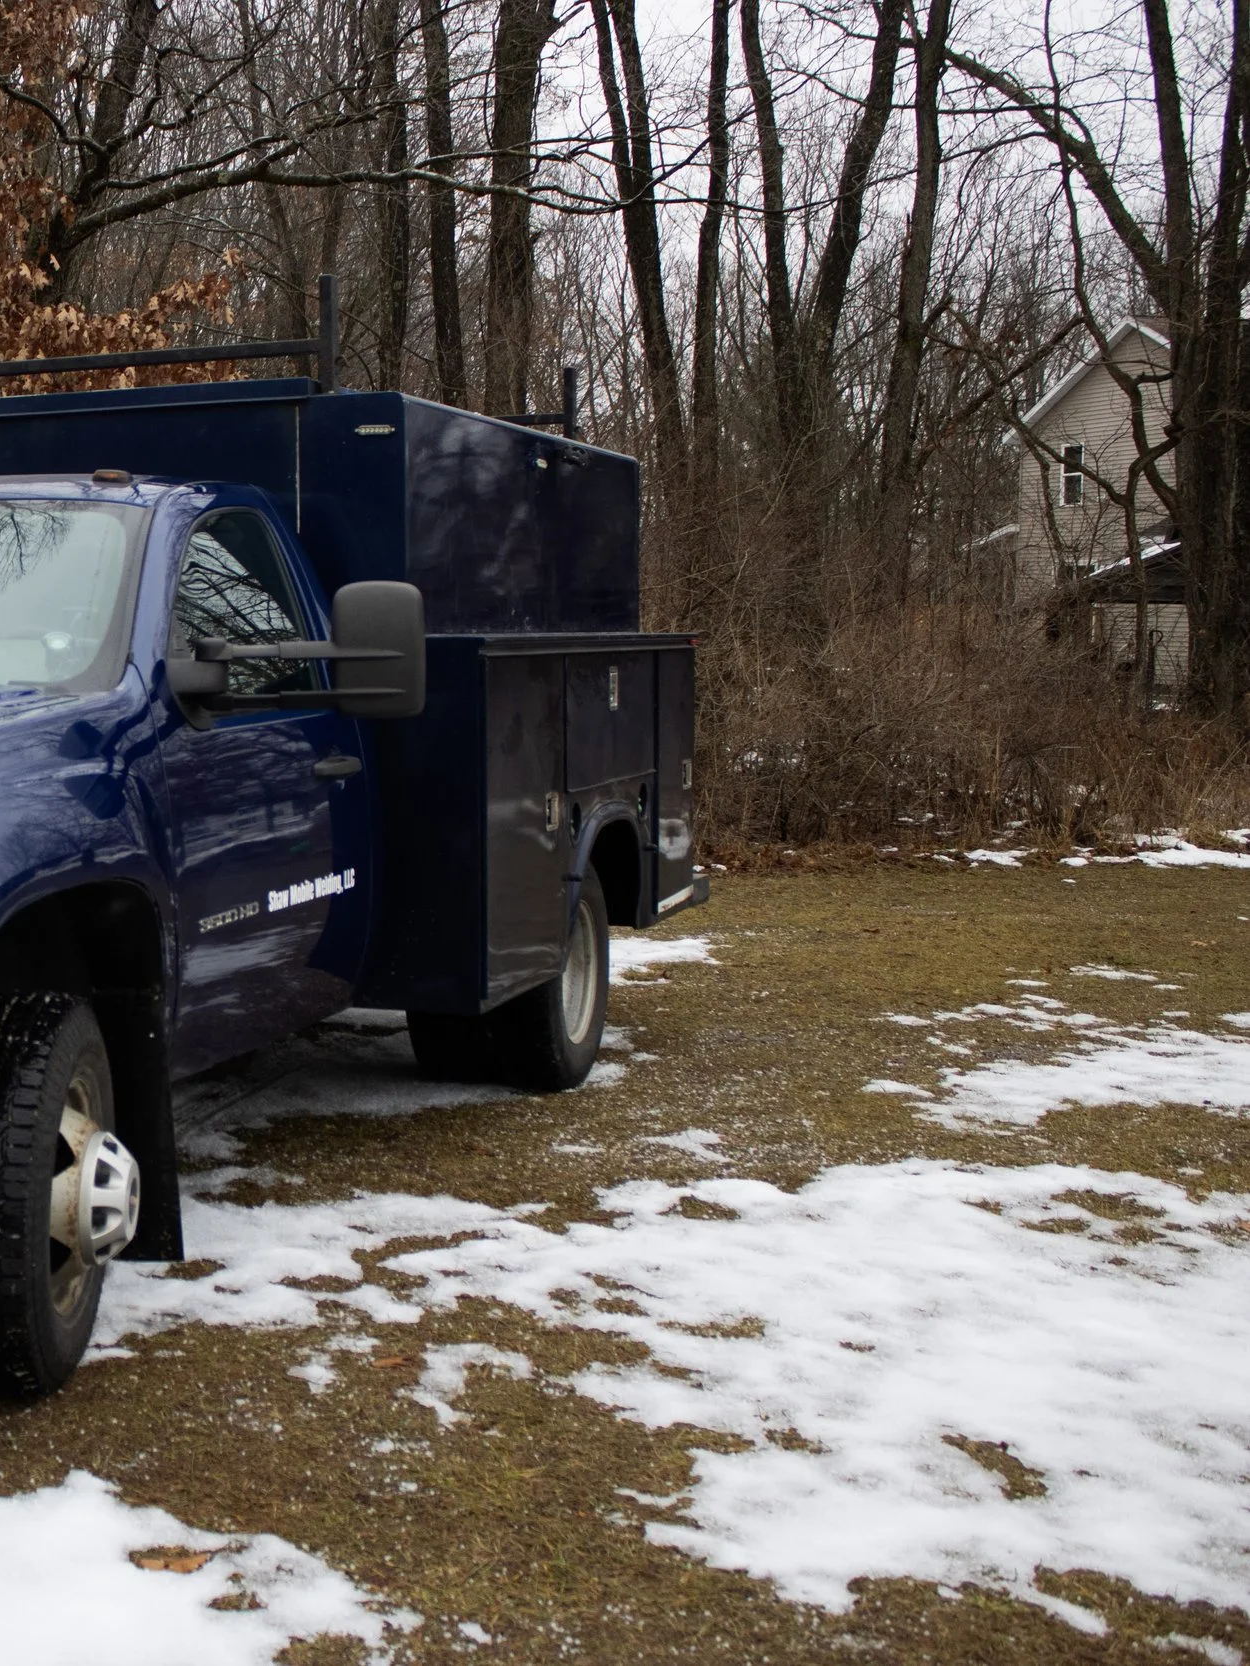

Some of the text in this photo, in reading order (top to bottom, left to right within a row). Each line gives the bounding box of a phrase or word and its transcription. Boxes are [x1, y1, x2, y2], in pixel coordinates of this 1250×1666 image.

[268, 867, 355, 912] Shaw Mobile Welding, LLC
